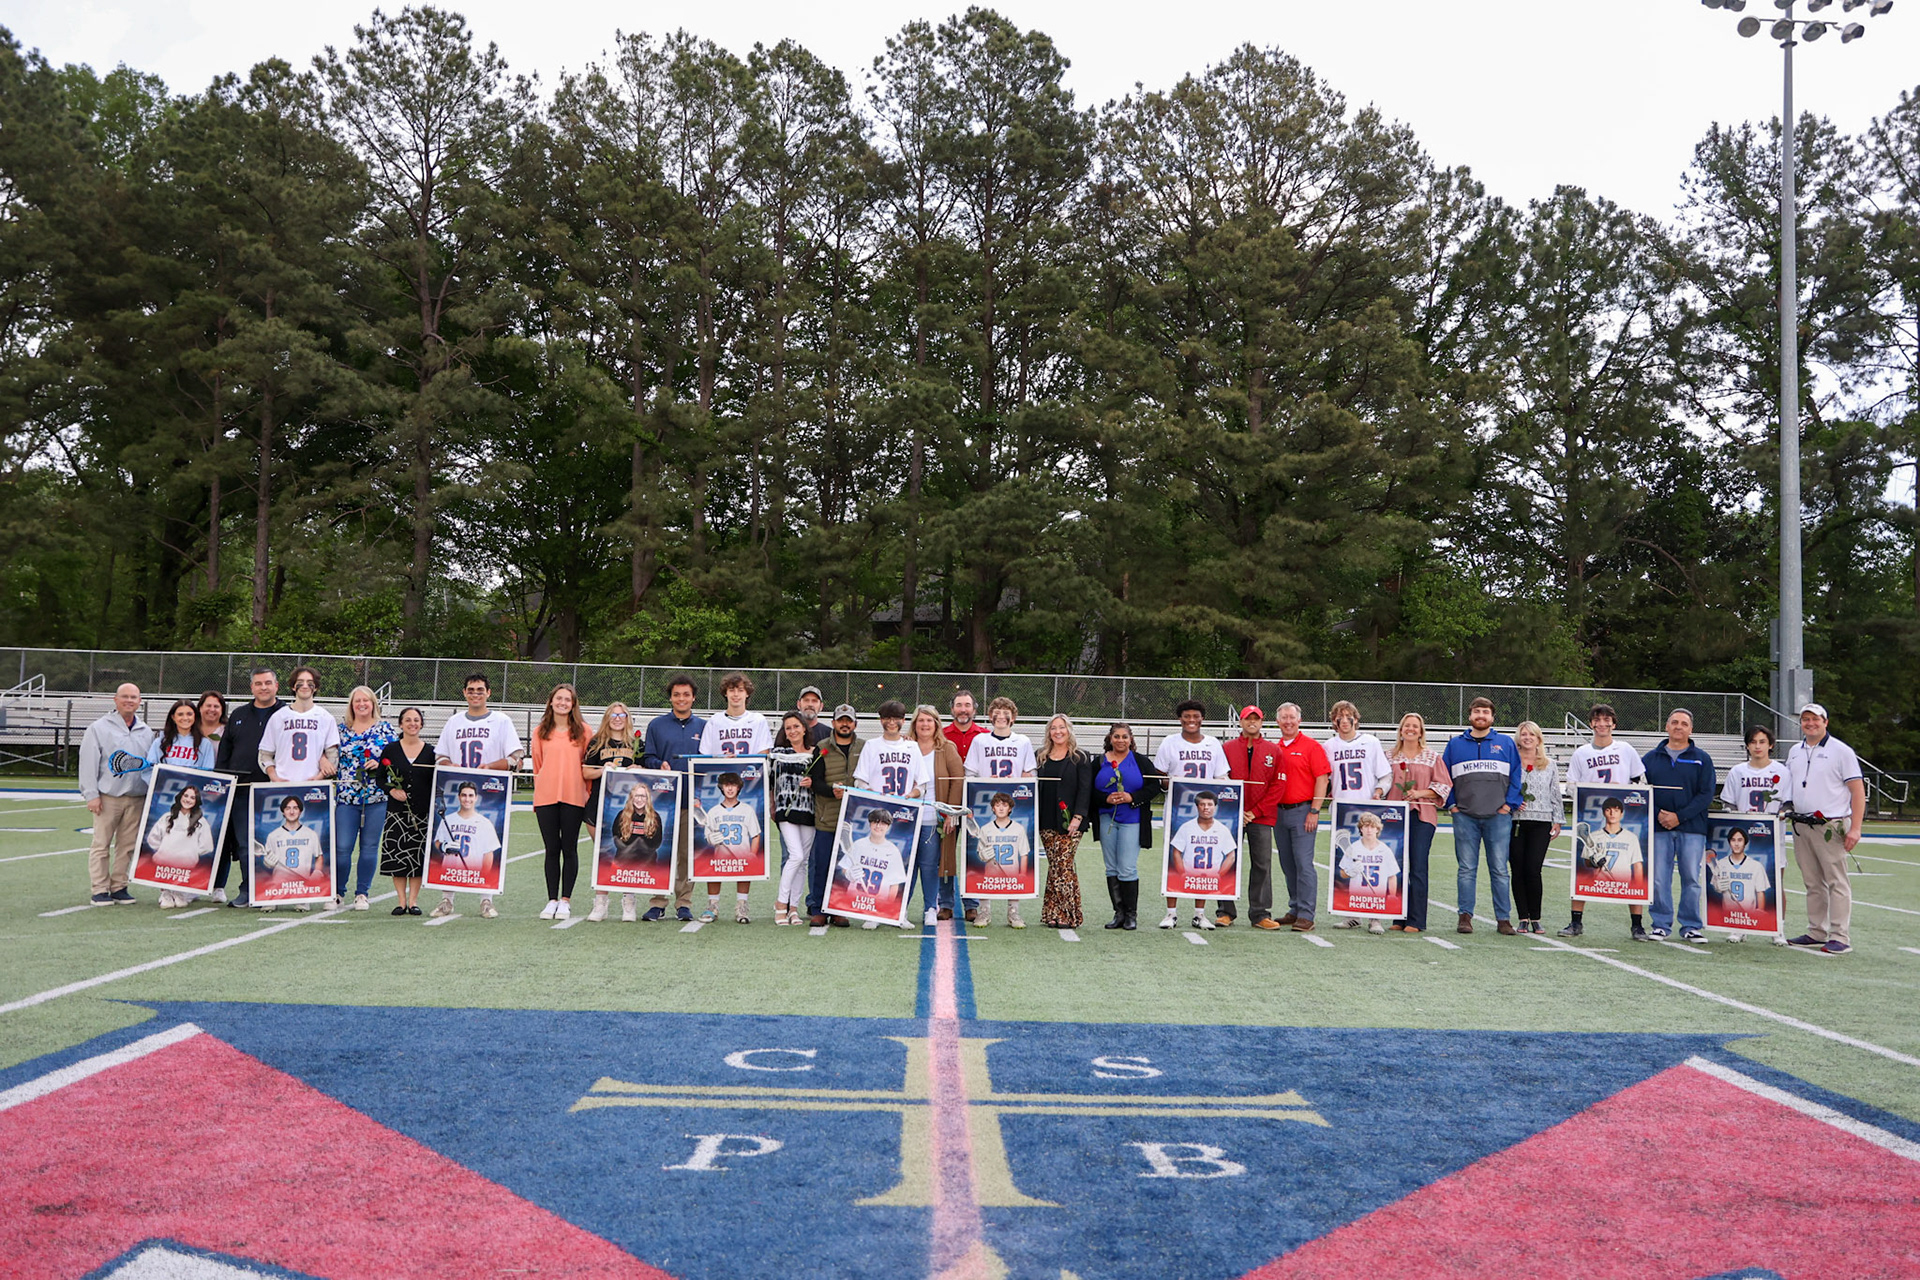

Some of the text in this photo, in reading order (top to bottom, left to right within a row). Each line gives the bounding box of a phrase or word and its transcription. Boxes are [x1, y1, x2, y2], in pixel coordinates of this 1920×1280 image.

[284, 720, 319, 730] EAGLES
[456, 728, 490, 739] EAGLES
[719, 728, 752, 740] EAGLES
[292, 732, 308, 761] 8
[984, 747, 1018, 757] EAGLES
[166, 746, 199, 759] SBA
[460, 740, 484, 768] 16
[1179, 750, 1212, 761] EAGLES
[1334, 750, 1366, 761] EAGLES
[879, 753, 911, 765] EAGLES
[1586, 754, 1620, 768] EAGLES
[990, 760, 1012, 777] 12
[1463, 762, 1498, 772] MEMPHIS
[882, 766, 908, 795] 39
[1339, 762, 1362, 790] 15
[1597, 769, 1612, 783] 7
[1740, 777, 1774, 788] EAGLES
[450, 825, 477, 834] EAGLES
[1191, 835, 1218, 845] EAGLES
[1606, 842, 1629, 850] BENEDICT
[285, 848, 300, 868] 8
[993, 844, 1014, 865] 12
[1194, 846, 1213, 869] 21
[860, 855, 888, 870] EAGLES
[1605, 851, 1620, 870] 7
[156, 865, 191, 877] MADDIE
[445, 869, 480, 877] JOSEPH
[616, 869, 650, 878] RACHEL
[714, 865, 744, 873] WEBER
[155, 871, 190, 883] DUFFEE
[440, 874, 485, 884] McCUSKER
[610, 875, 655, 885] SCHIRMER
[1185, 876, 1219, 884] JOSHUA
[1730, 872, 1753, 880] BENEDICT
[1184, 883, 1219, 891] PARKER
[1593, 880, 1629, 888] JOSEPH
[265, 886, 321, 896] HOFFMEYER
[1579, 885, 1644, 896] FRANCESCHINI
[1730, 881, 1745, 901] 9
[855, 896, 875, 904] LUIS
[1349, 896, 1385, 904] ANDREW
[851, 901, 878, 912] VIDAL
[1349, 902, 1385, 910] McALPIN
[1730, 911, 1750, 919] WILL
[1724, 917, 1758, 926] DABNEY
[724, 1048, 818, 1071] C
[1091, 1055, 1163, 1079] S
[661, 1133, 785, 1171] P
[1120, 1141, 1247, 1178] B
